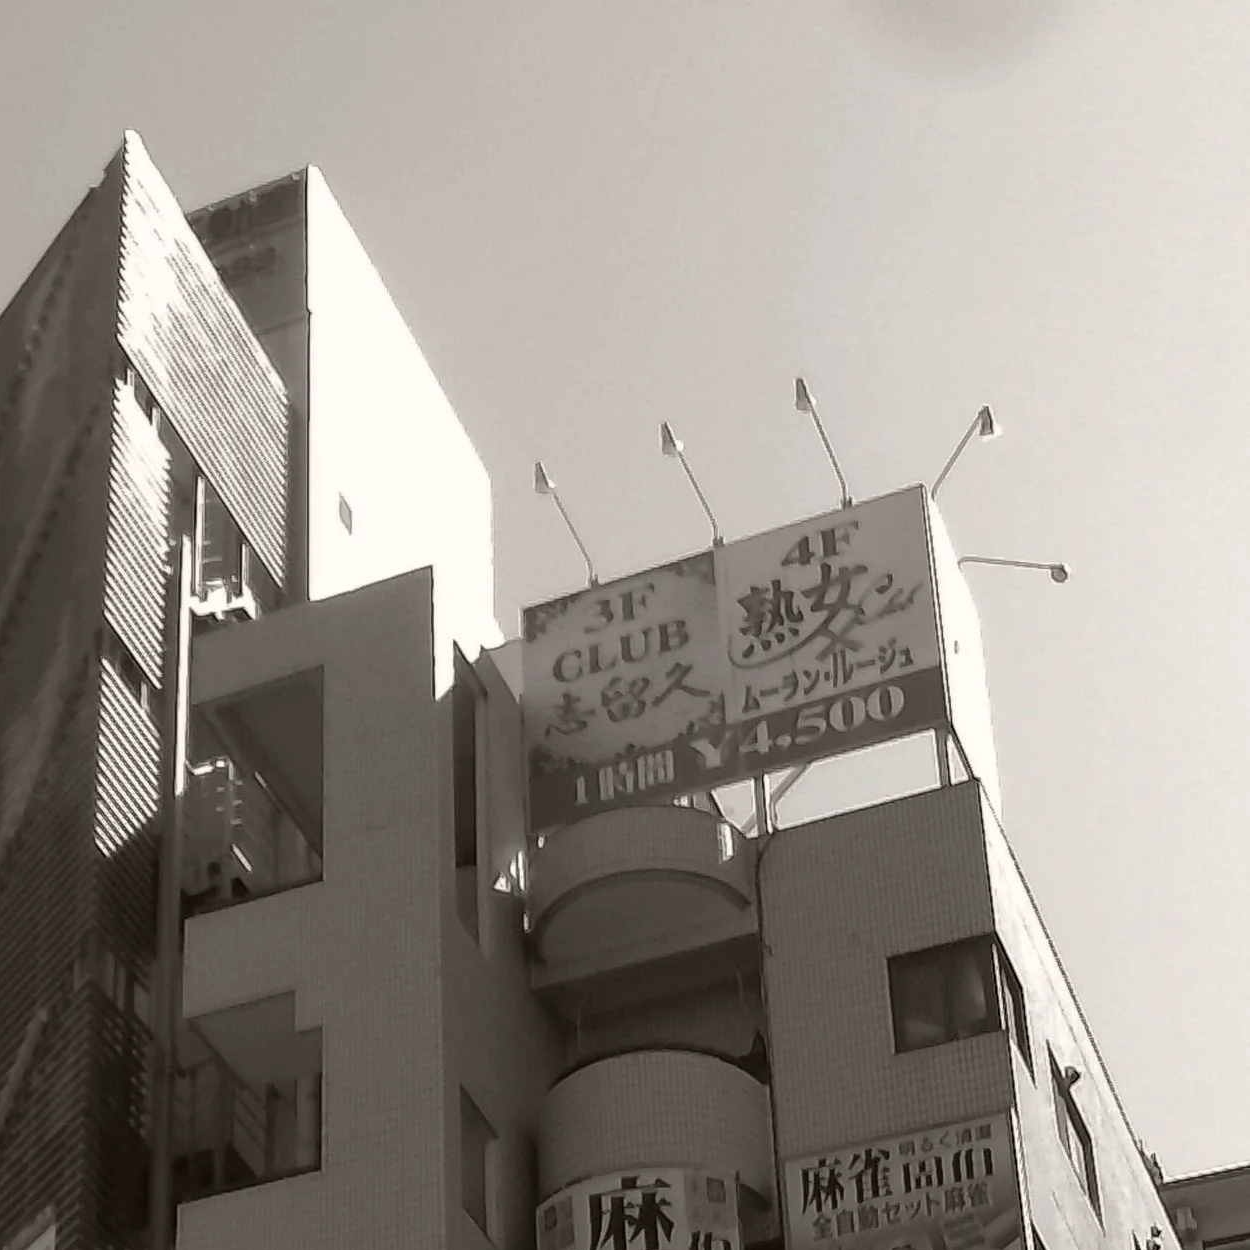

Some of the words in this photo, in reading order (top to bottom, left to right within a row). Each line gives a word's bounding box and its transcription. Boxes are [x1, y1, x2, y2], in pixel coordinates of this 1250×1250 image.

[781, 520, 860, 567] 4F
[584, 581, 655, 634] 3F
[552, 618, 690, 683] CLUB
